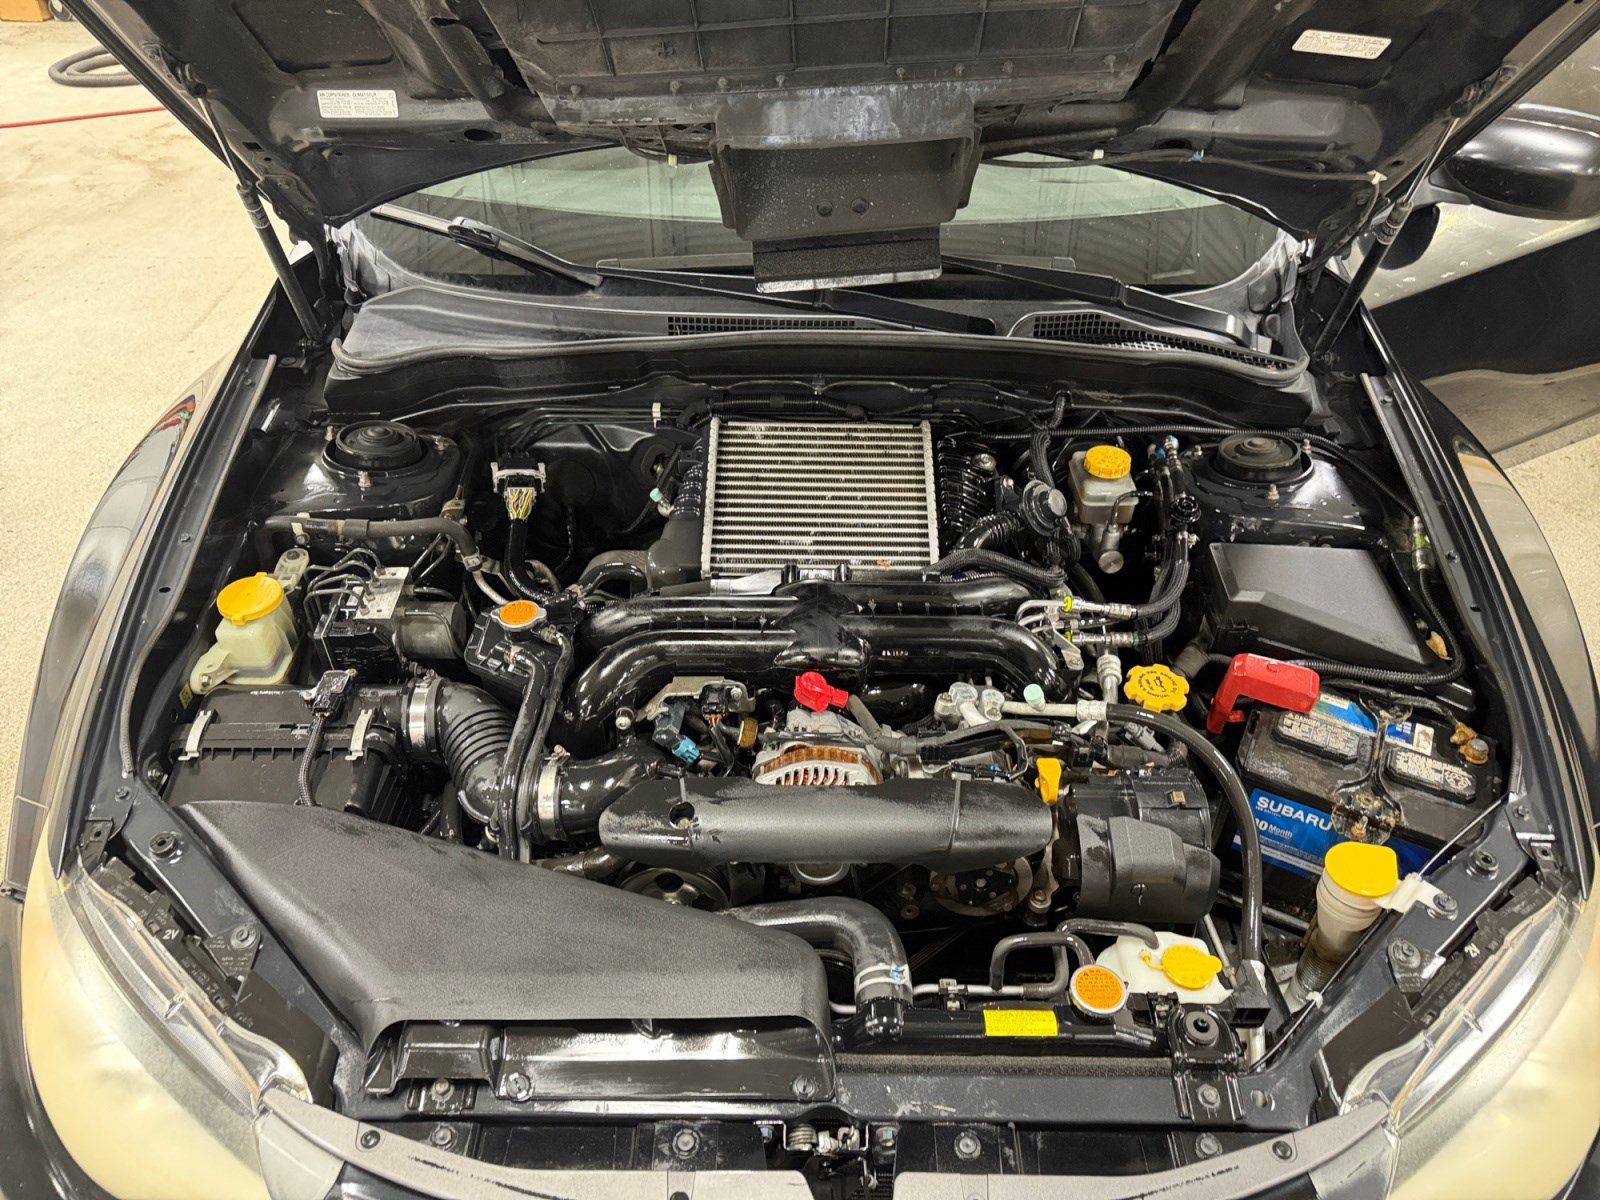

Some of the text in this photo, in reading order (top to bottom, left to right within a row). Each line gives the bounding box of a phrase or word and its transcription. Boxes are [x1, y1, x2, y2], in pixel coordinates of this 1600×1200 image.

[1256, 796, 1332, 831] SUBARU
[1268, 824, 1293, 840] Month
[162, 928, 180, 940] 2V
